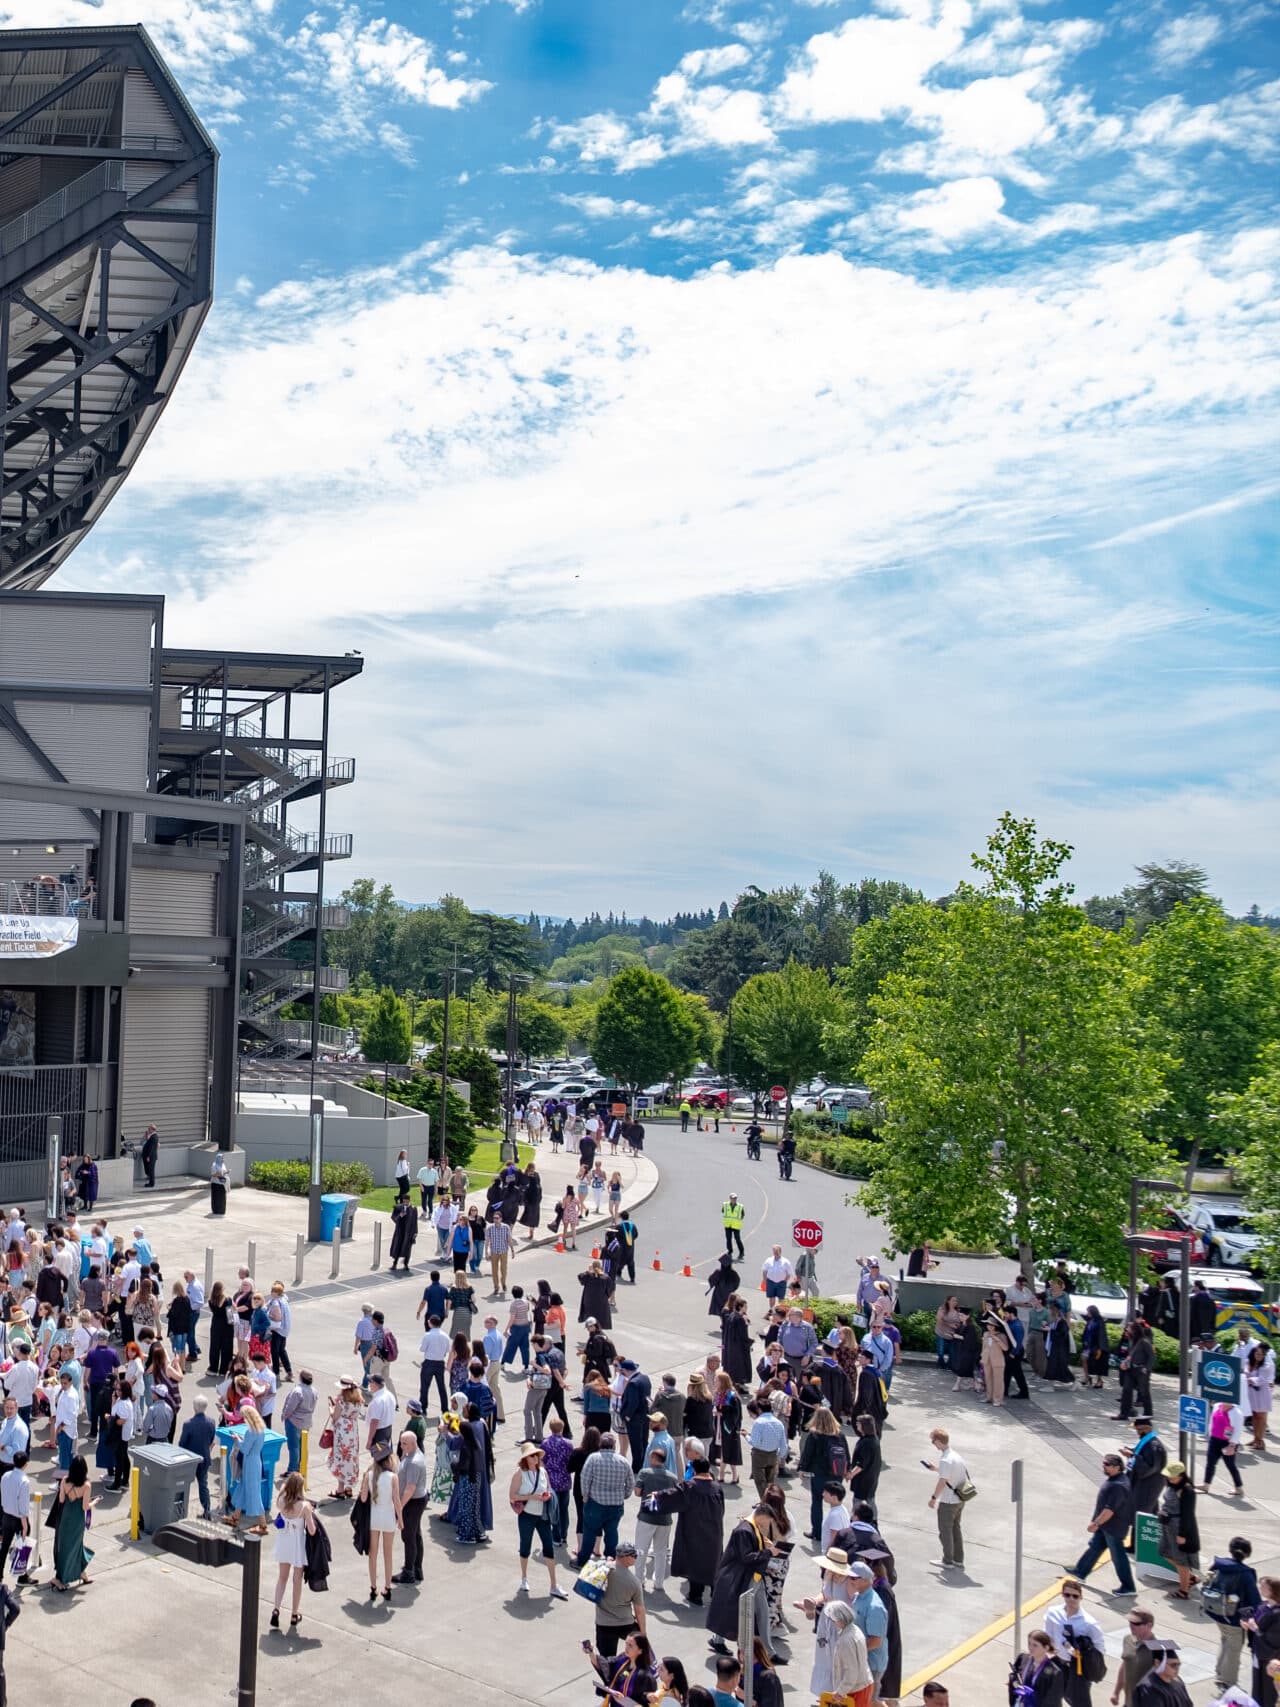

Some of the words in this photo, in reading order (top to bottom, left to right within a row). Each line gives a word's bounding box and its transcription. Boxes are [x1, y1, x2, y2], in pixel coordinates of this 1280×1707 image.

[23, 930, 42, 940] Field
[13, 943, 37, 952] Ticket
[794, 1227, 822, 1241] STOP
